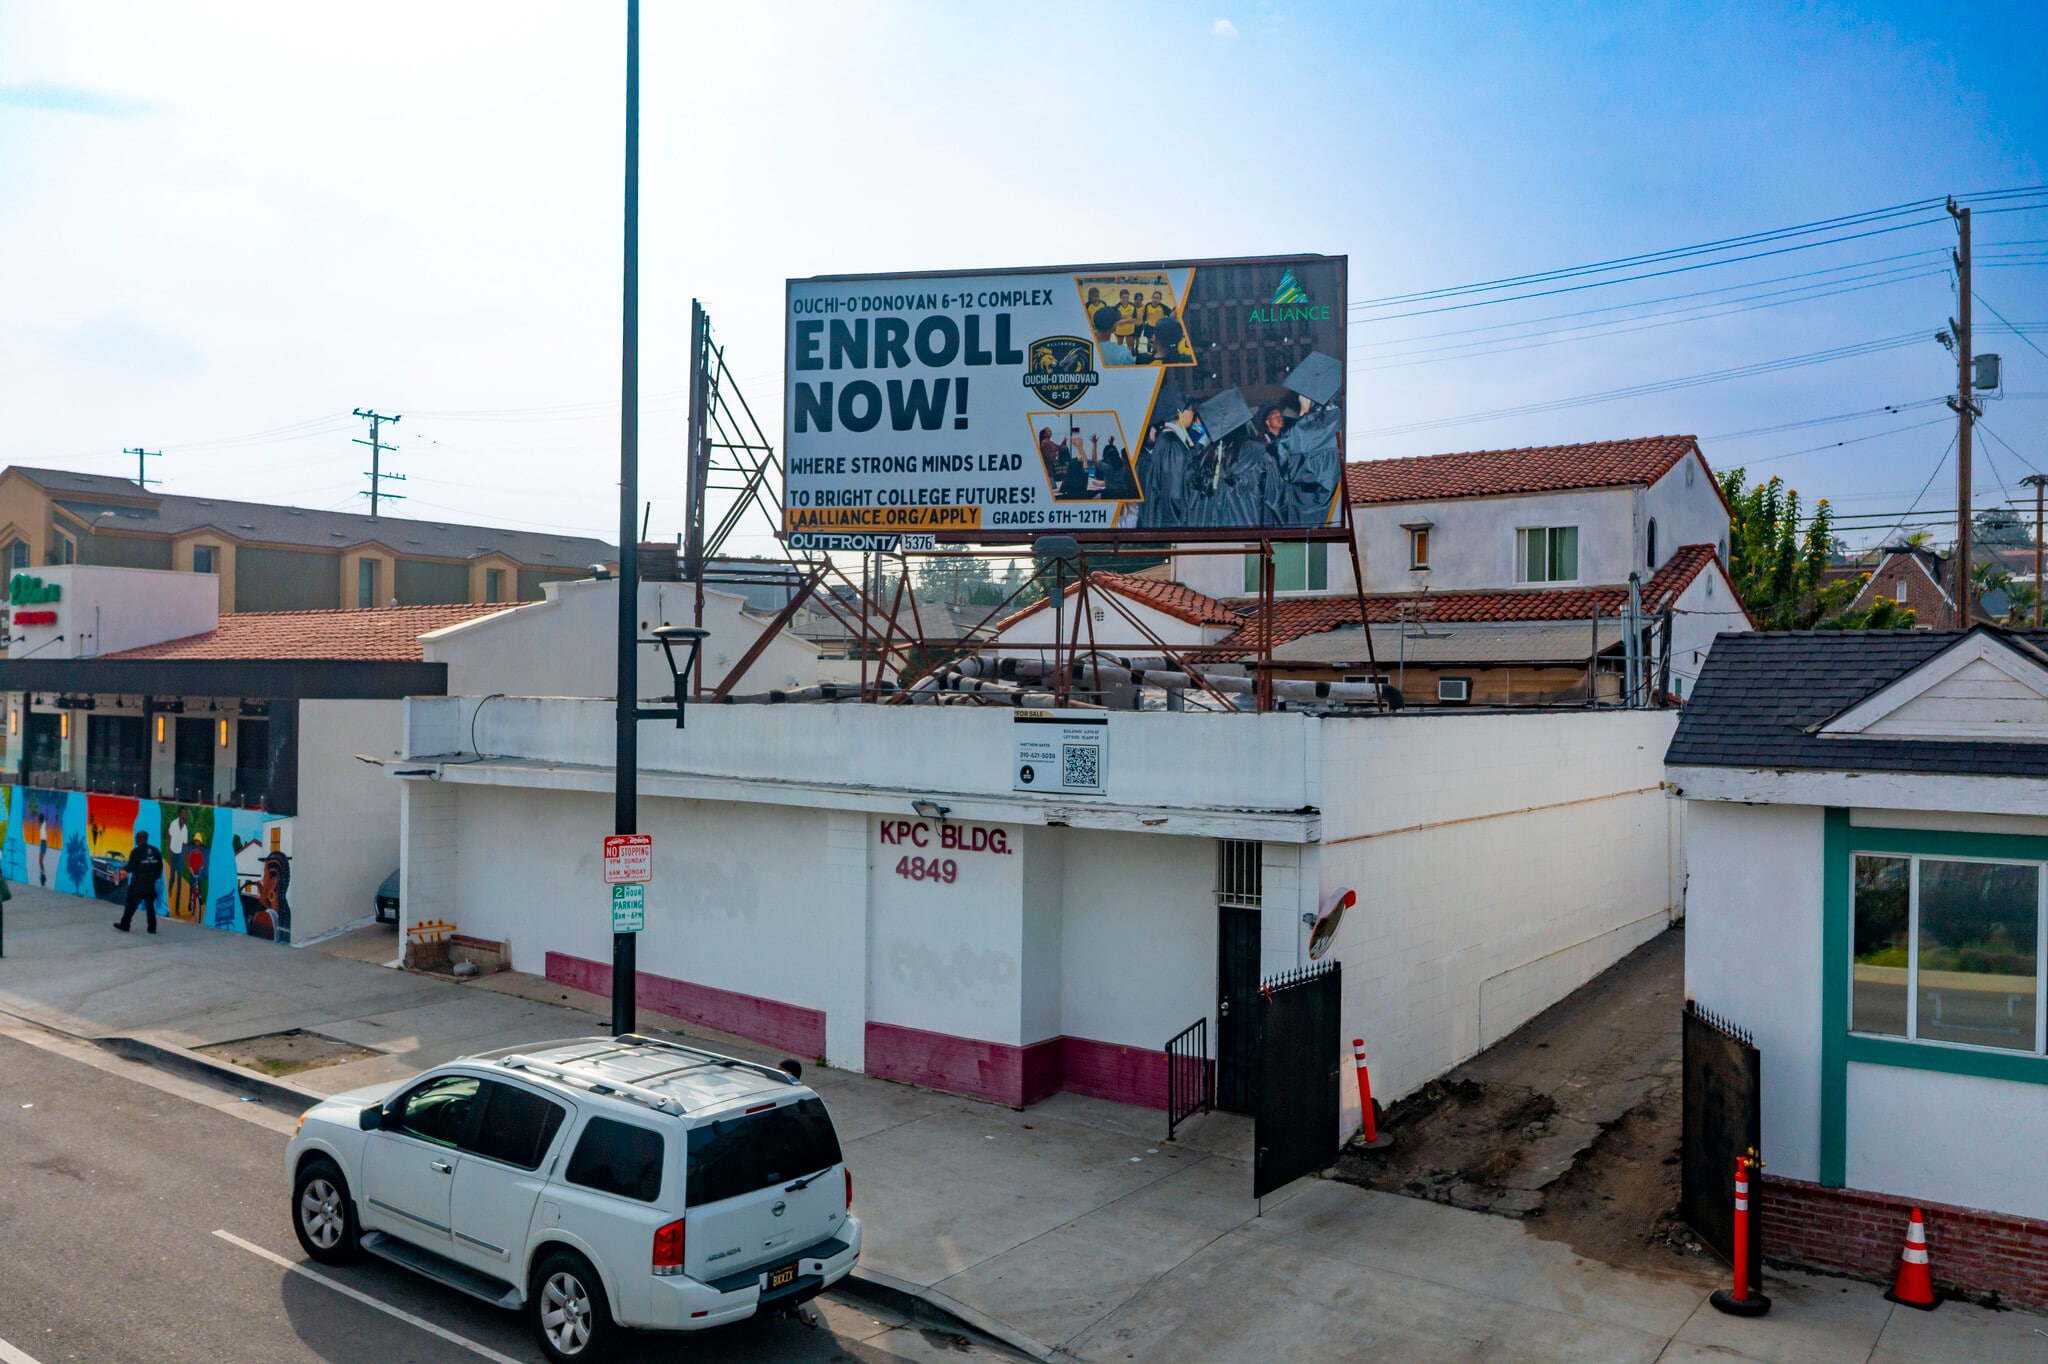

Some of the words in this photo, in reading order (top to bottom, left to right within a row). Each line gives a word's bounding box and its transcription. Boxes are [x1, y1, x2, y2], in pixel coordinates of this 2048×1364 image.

[793, 294, 937, 314] OUCHI-O'DONOVAN
[941, 293, 973, 309] 6-12
[978, 289, 1053, 308] COMPLEX
[1248, 305, 1330, 323] ALLIANCE
[795, 313, 1024, 371] ENROLL
[1024, 373, 1097, 385] OUCHI-O'DONOVAN
[1051, 391, 1070, 399] 6-12
[794, 376, 969, 433] NOW!
[790, 457, 846, 474] WHERE
[851, 456, 917, 474] STRONG
[922, 454, 974, 472] MINDS
[978, 454, 1023, 471] LEAD
[790, 490, 810, 506] TO
[815, 489, 873, 506] BRIGHT
[877, 488, 951, 506] COLLEGE
[956, 487, 1035, 505] FUTURES!
[789, 508, 978, 526] LAALLIANCE.ORG/APPLY
[992, 510, 1045, 524] GRADES
[1049, 510, 1107, 523] 6TH-12TH
[904, 535, 933, 550] 5376
[880, 820, 929, 848] KPC
[941, 824, 1012, 855] BLDG.
[606, 846, 618, 857] NO
[620, 846, 649, 857] STOPPING
[895, 855, 958, 884] 4849
[615, 887, 623, 898] 2
[614, 900, 642, 910] PARKING
[614, 912, 626, 920] 8AM
